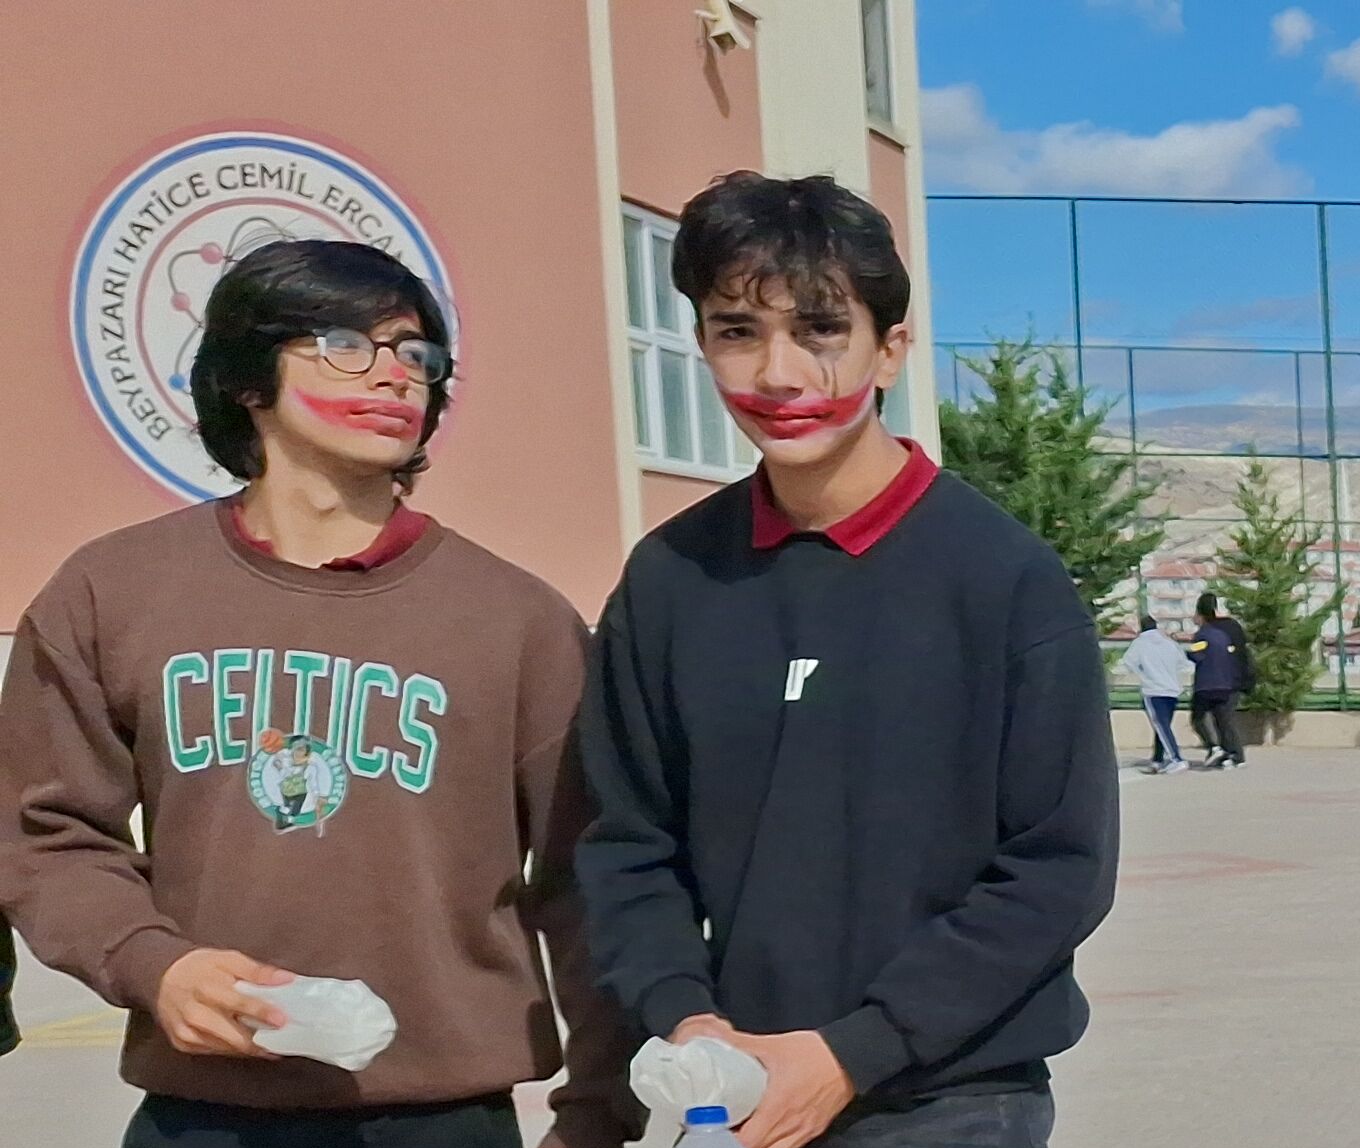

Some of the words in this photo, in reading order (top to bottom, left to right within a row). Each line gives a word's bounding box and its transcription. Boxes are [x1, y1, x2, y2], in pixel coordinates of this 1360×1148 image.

[114, 172, 211, 265] HATİCE
[217, 162, 314, 199] CEMİL
[321, 183, 404, 261] ERCA
[100, 266, 172, 442] BEYPAZARI
[162, 647, 448, 795] CELTICS
